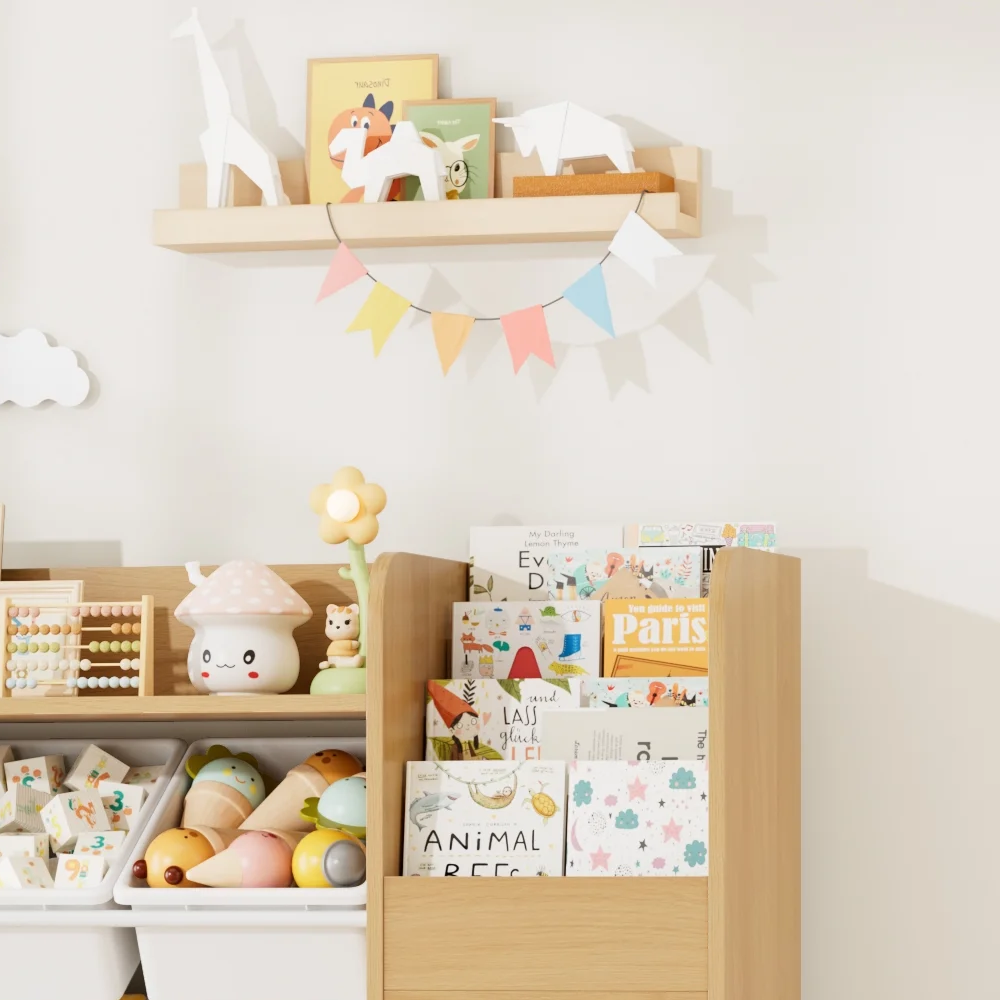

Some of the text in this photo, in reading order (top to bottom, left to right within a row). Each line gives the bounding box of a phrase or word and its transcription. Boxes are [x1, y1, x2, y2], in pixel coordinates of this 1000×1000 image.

[529, 530, 575, 539] My Darling
[524, 540, 579, 548] Lemon Thyme
[519, 550, 549, 568] Ev
[612, 612, 707, 645] Paris
[527, 690, 560, 702] und
[503, 705, 537, 726] LASS
[697, 730, 707, 750] The
[109, 790, 124, 812] 3
[90, 836, 105, 849] 3
